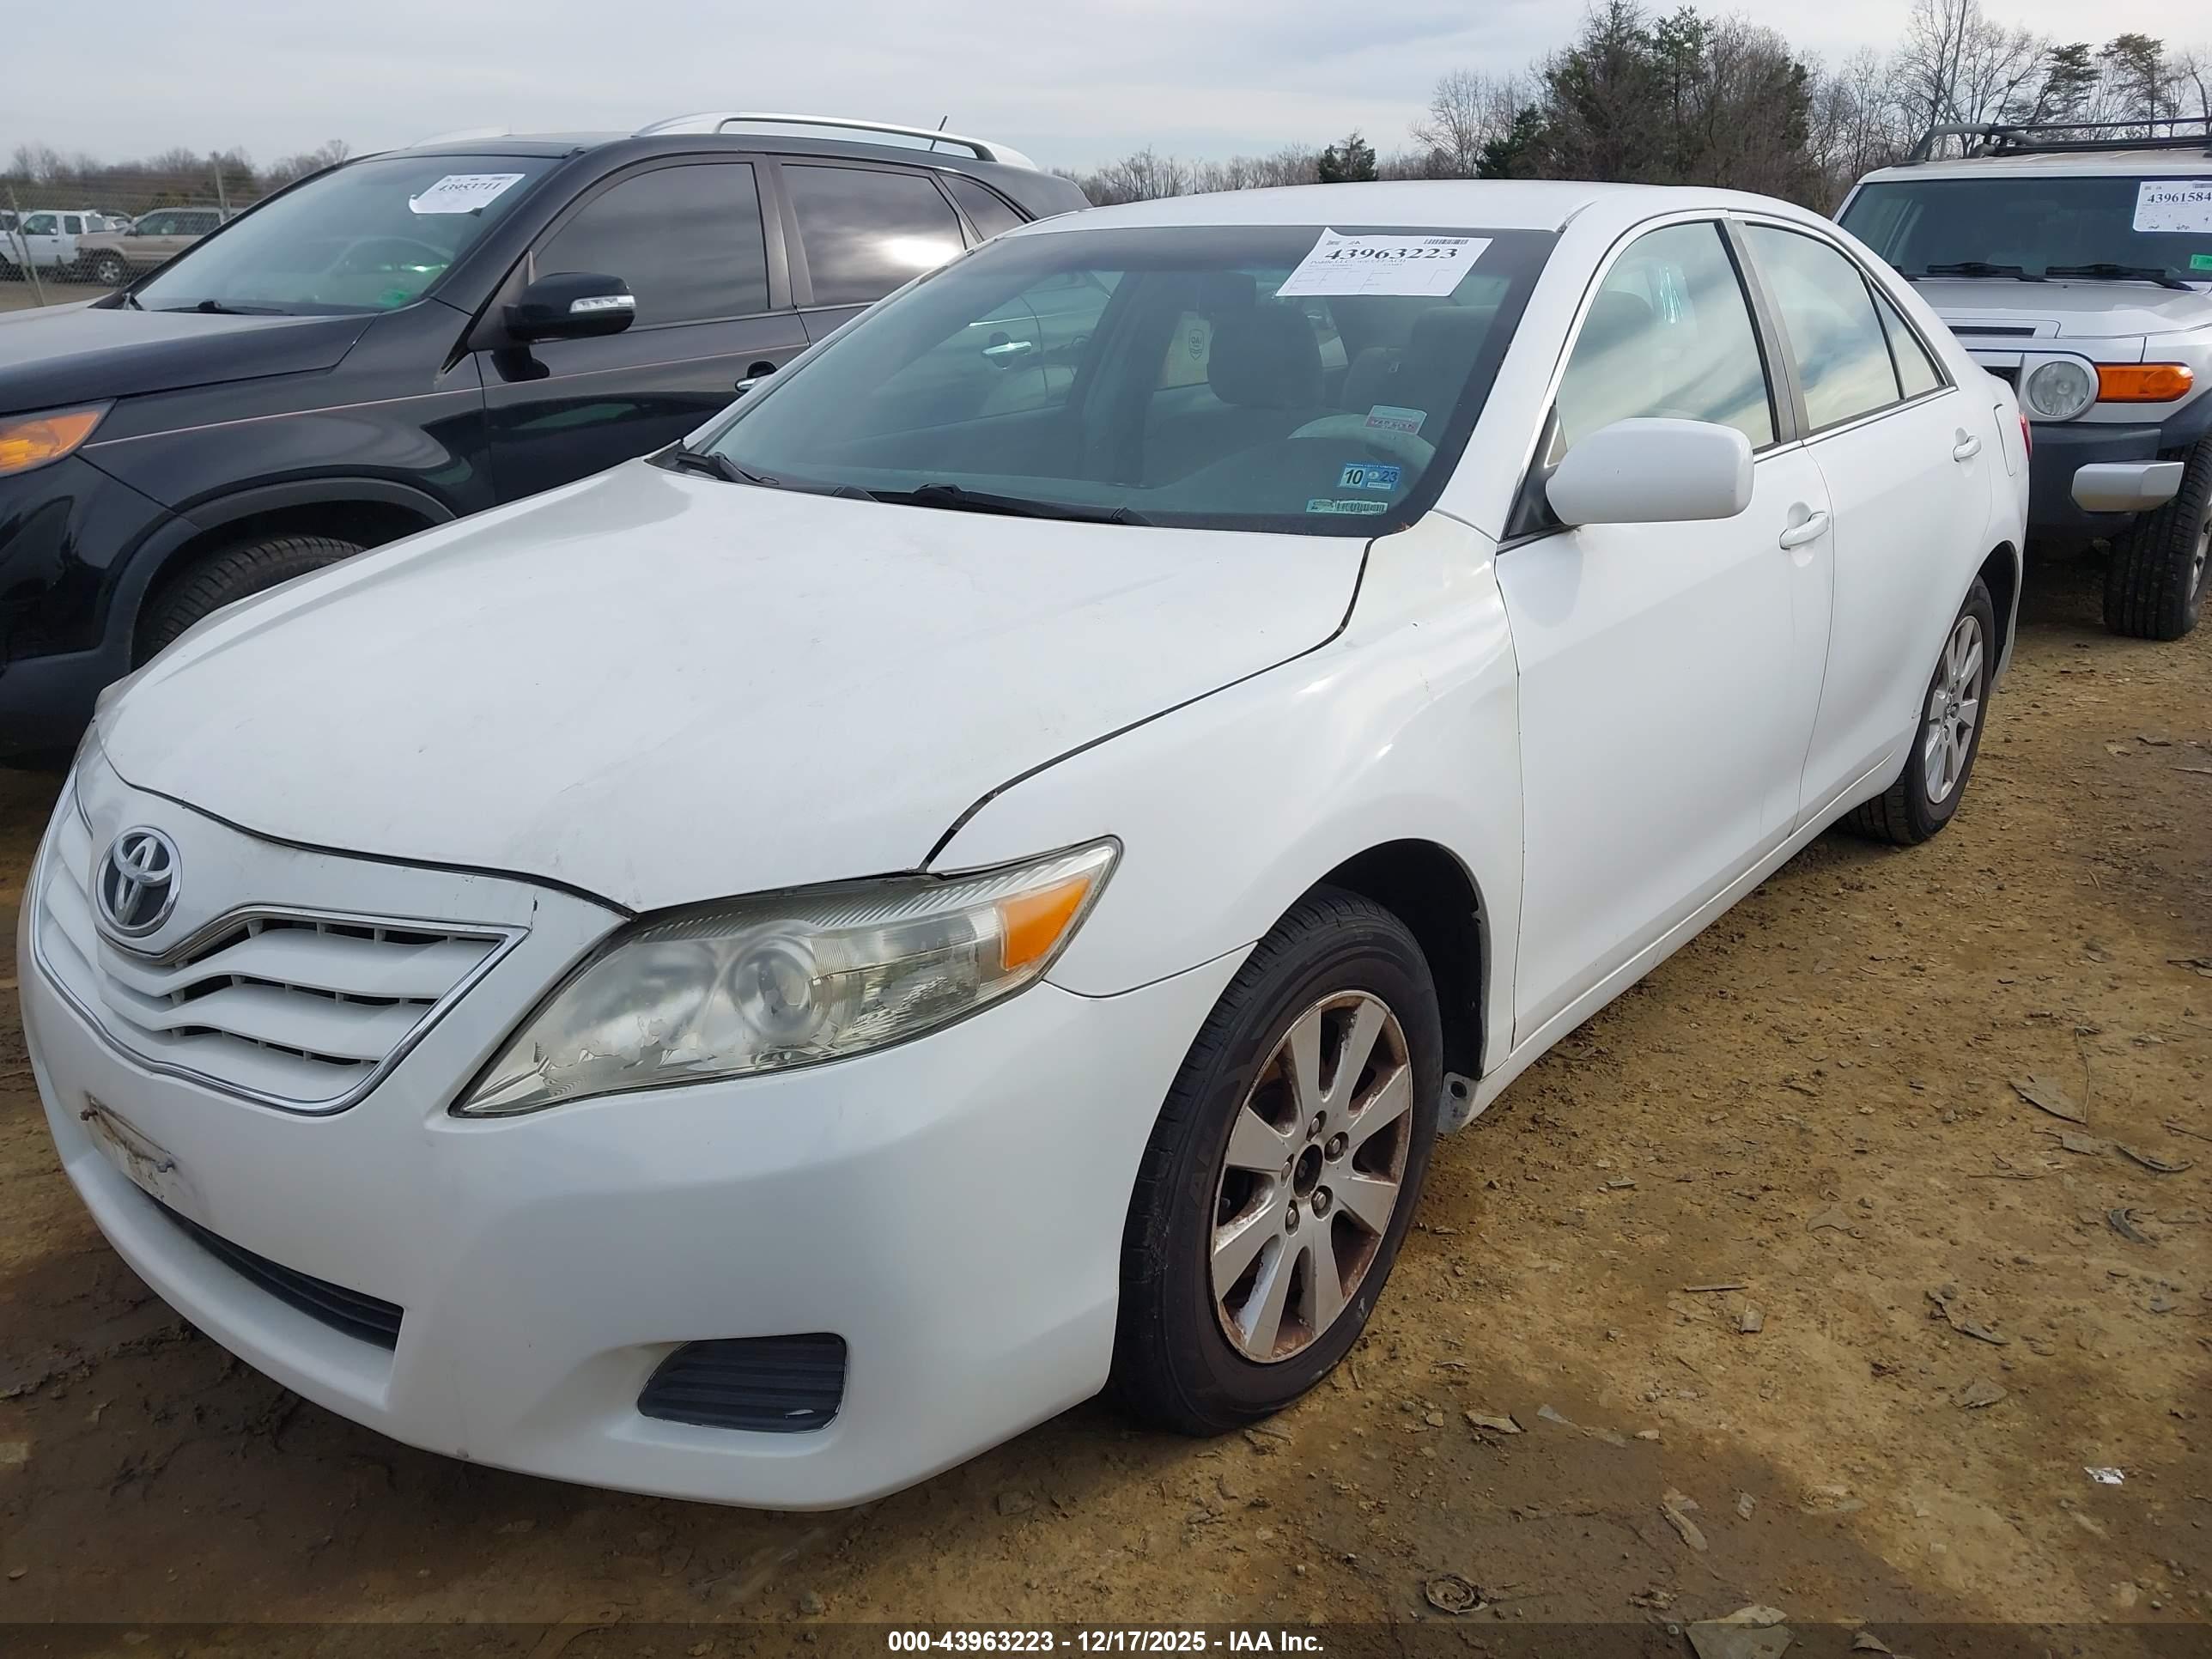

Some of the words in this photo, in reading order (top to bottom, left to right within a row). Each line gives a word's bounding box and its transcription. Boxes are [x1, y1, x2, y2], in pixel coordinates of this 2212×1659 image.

[2148, 191, 2212, 203] 43961584
[1326, 248, 1458, 260] 43963223
[1346, 469, 1364, 484] 10
[1381, 471, 1399, 483] 23
